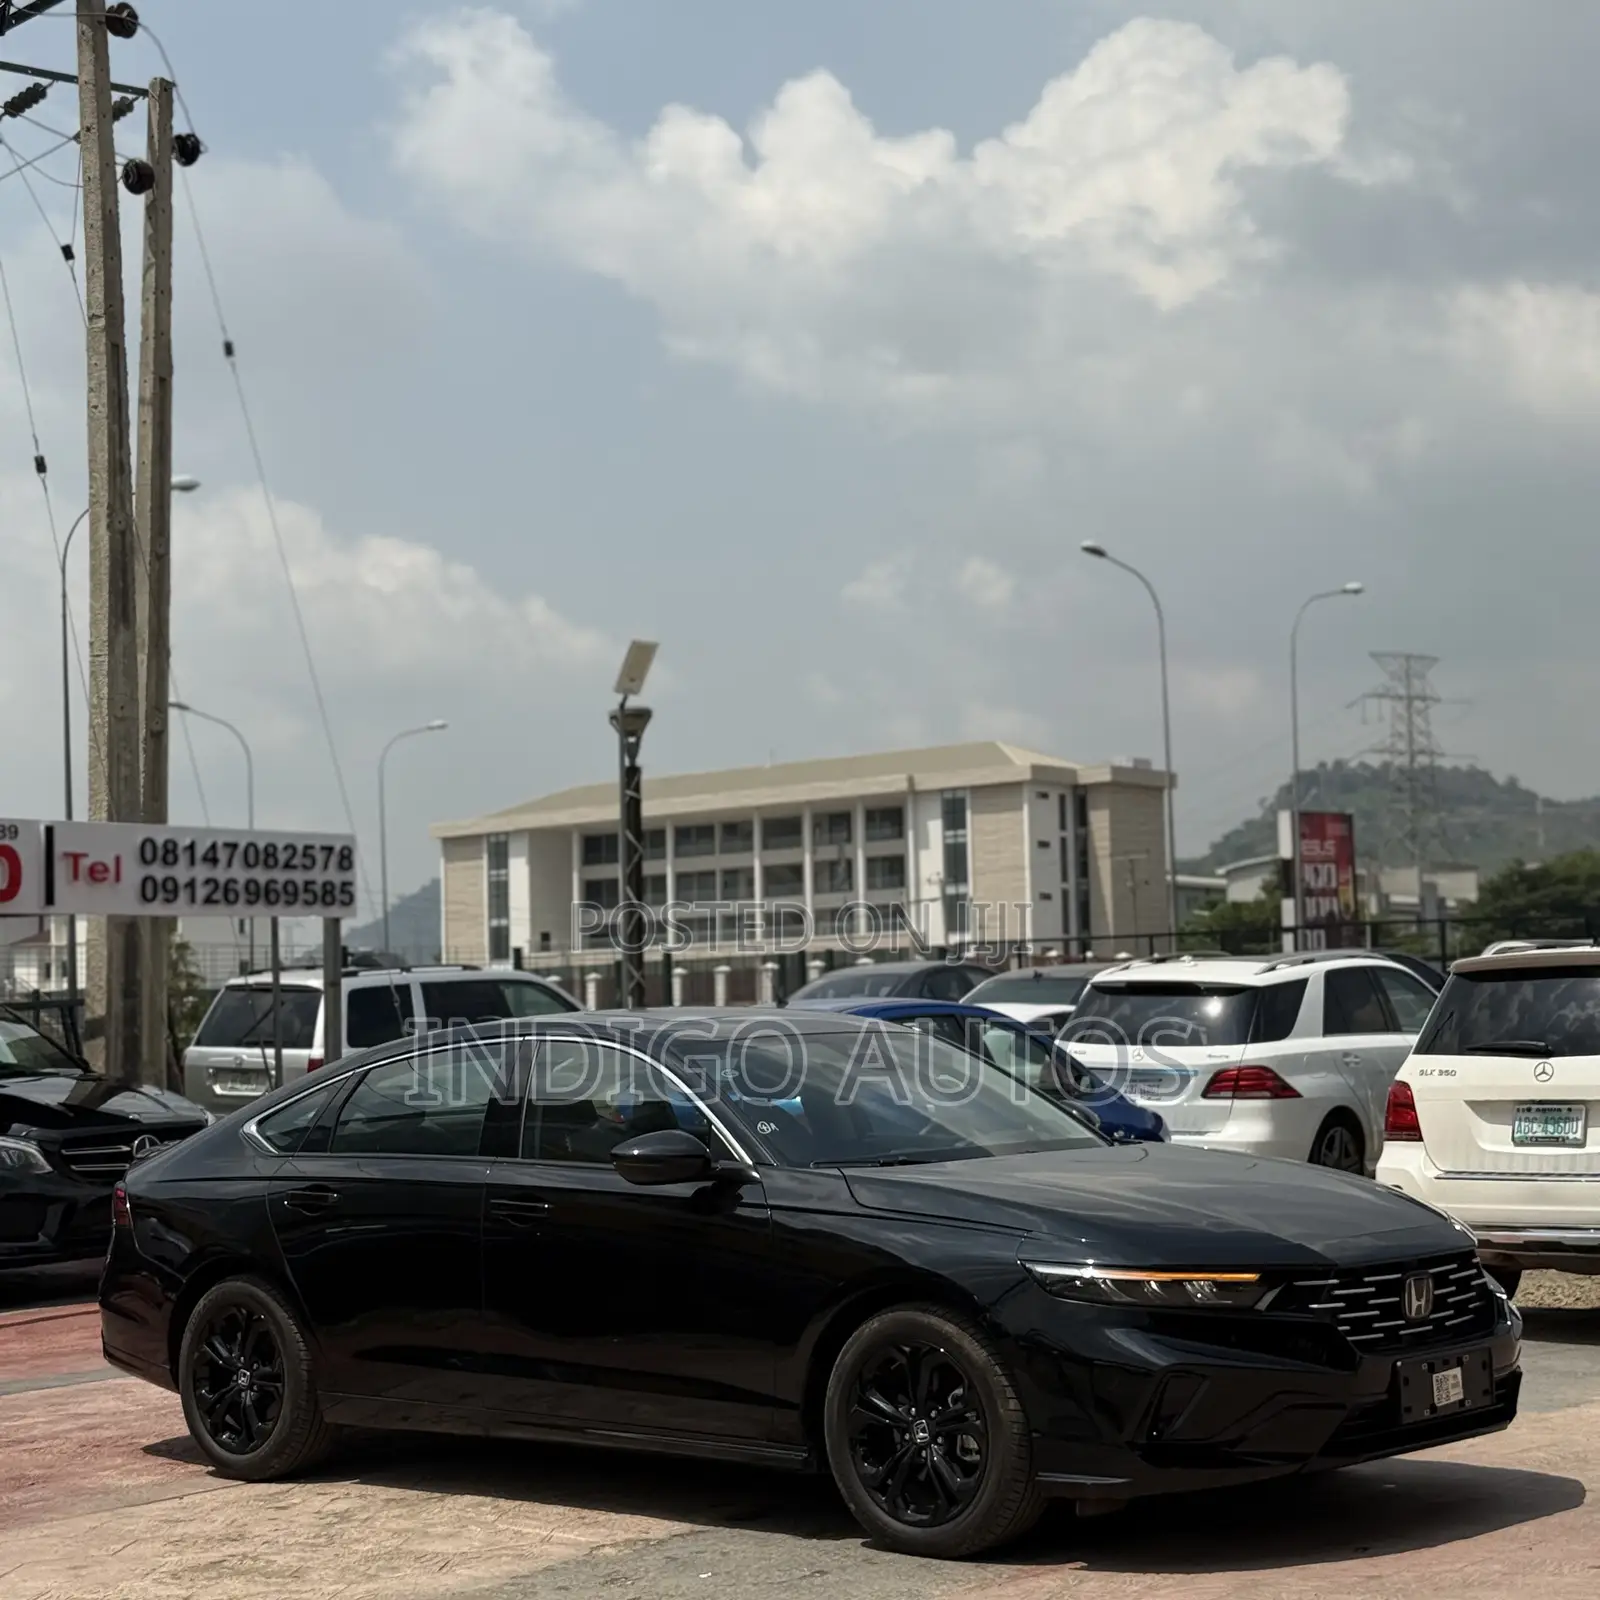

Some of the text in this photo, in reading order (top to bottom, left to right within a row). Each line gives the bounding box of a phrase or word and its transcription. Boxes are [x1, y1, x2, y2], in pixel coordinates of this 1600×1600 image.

[63, 852, 121, 883] Tel
[139, 837, 354, 872] 08147082578
[140, 875, 355, 907] 09126969585
